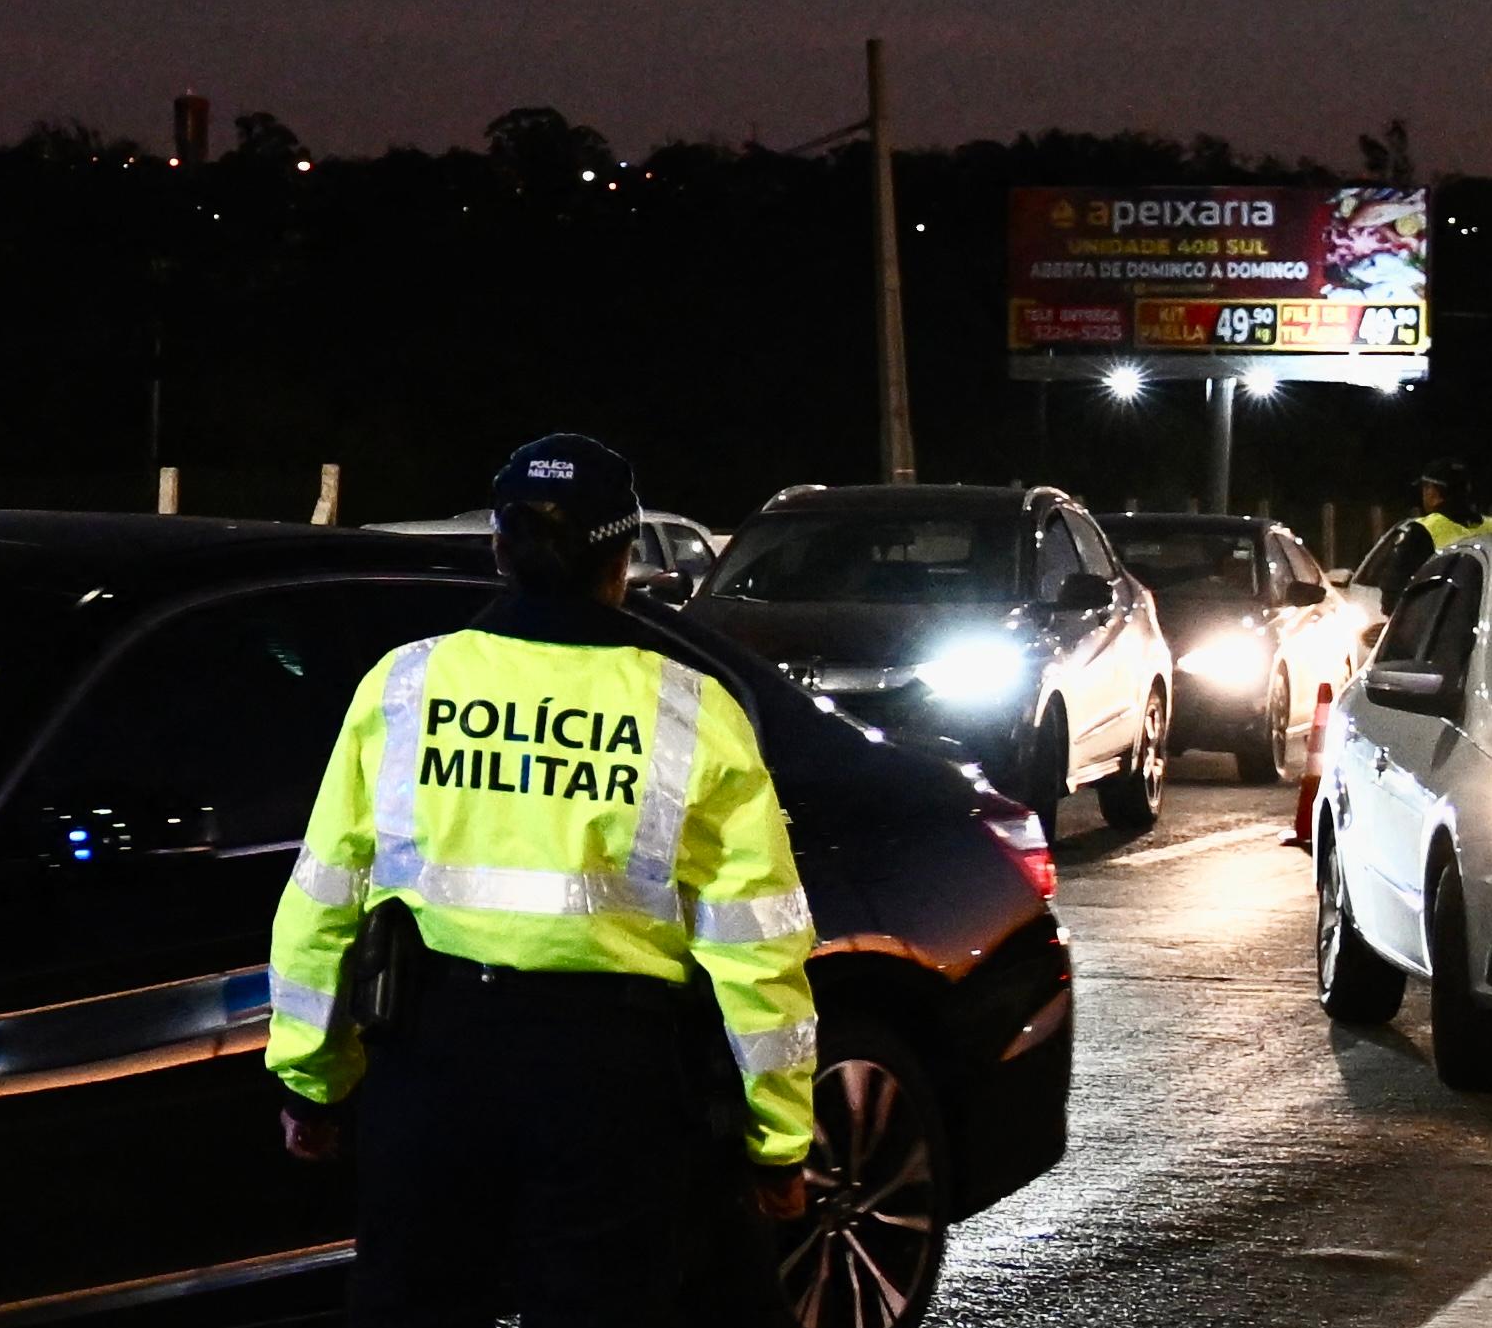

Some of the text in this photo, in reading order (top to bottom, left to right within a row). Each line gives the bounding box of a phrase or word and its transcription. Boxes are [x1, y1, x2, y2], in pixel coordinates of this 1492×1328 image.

[1226, 238, 1269, 256] SUL
[1100, 261, 1122, 279] DE
[1126, 261, 1207, 280] DOMINGO
[1209, 261, 1223, 279] A
[1226, 260, 1310, 280] DOMINGO
[527, 467, 575, 480] MILITAR
[529, 458, 575, 471] POLÍCIA
[425, 696, 643, 755] POLÍCIA
[419, 745, 640, 806] MILITAR
